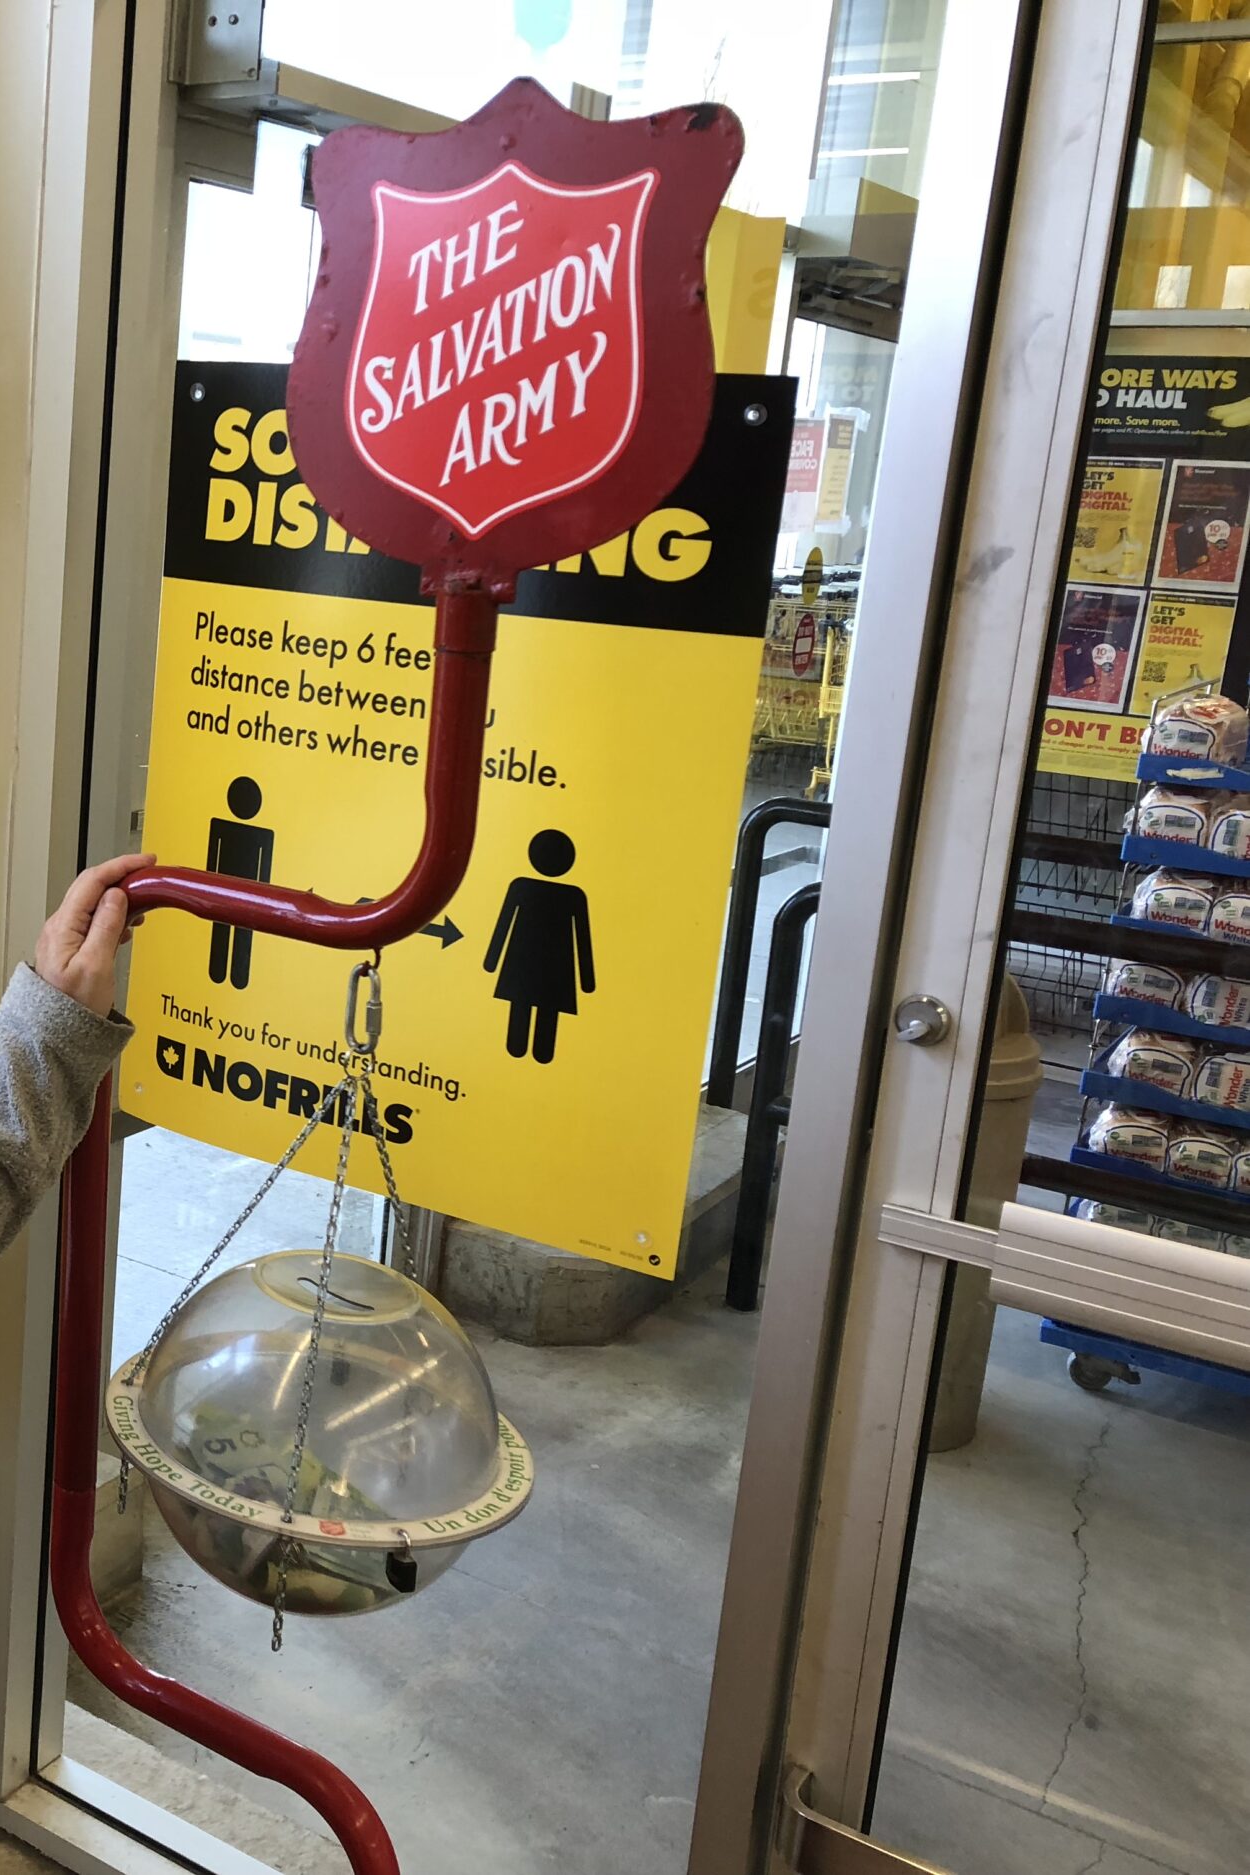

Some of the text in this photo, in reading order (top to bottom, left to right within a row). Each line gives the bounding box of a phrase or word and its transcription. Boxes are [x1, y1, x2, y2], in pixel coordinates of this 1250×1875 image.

[407, 200, 525, 316] THE
[360, 223, 622, 434] SALVATION
[1100, 368, 1239, 390] ORE WAYS
[1115, 389, 1188, 410] HAUL
[439, 331, 607, 488] ARMY
[1125, 415, 1150, 427] Save
[1152, 417, 1181, 427] more.
[1150, 615, 1176, 625] GET
[1153, 606, 1185, 616] LET'S
[195, 611, 440, 671] Please keep 6 fee
[1149, 625, 1204, 640] DIGITAL,
[190, 655, 426, 719] distance between
[187, 705, 567, 790] and others where sible.
[1044, 718, 1112, 742] ON'T
[1153, 744, 1203, 760] Wonder
[1151, 911, 1201, 928] Wonder
[161, 995, 467, 1101] Thank you for understanding.
[192, 1048, 414, 1145] NOFRILLS
[1173, 1163, 1224, 1181] Wonder
[113, 1395, 263, 1519] Giving Hope Today
[421, 1520, 464, 1533] Un
[461, 1503, 503, 1524] don
[491, 1452, 531, 1503] d'espoir
